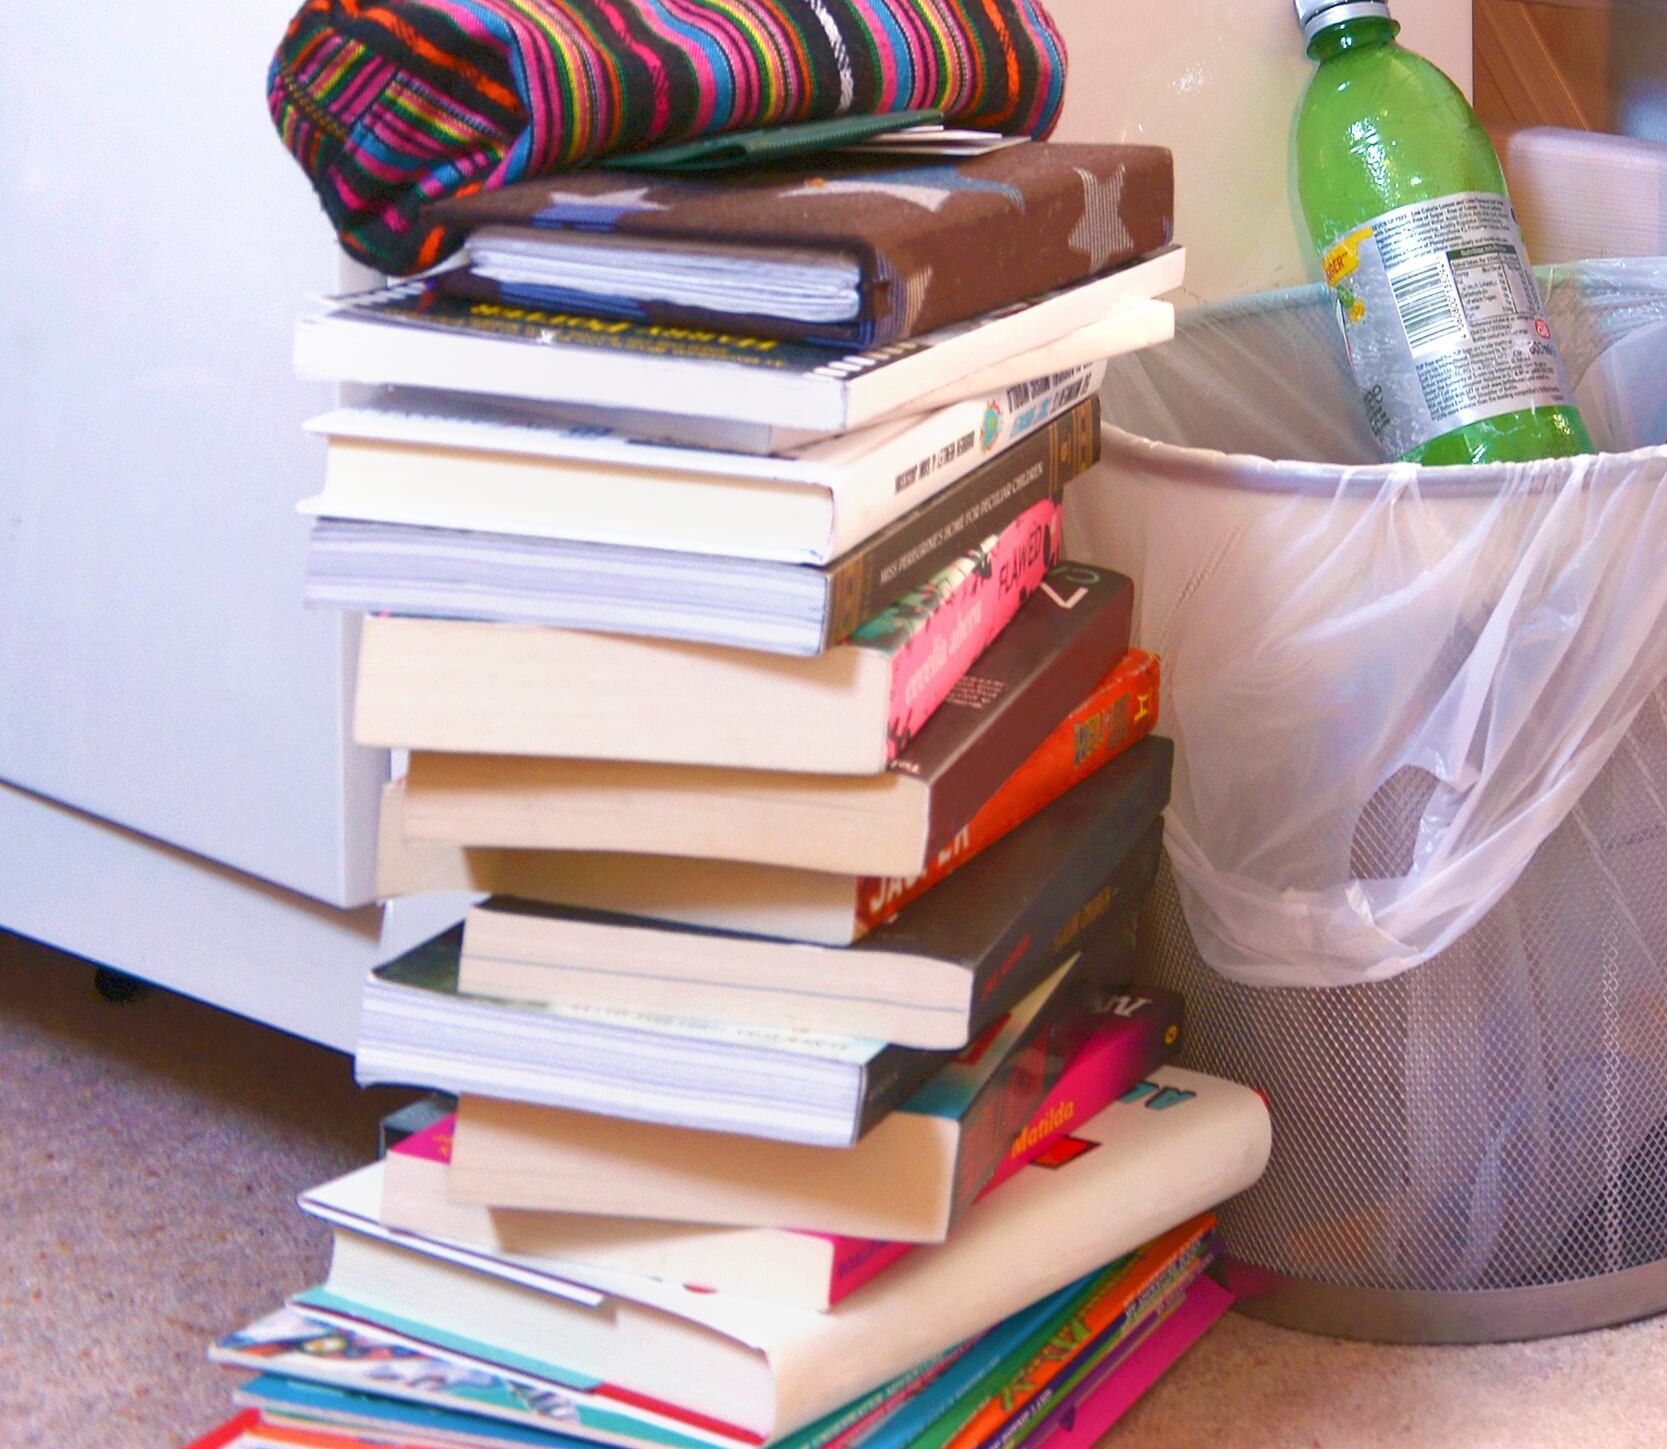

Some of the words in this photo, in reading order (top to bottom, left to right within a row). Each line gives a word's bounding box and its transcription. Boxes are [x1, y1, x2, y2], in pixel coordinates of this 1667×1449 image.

[880, 563, 898, 584] MISS
[943, 516, 965, 546] HOME
[965, 505, 980, 529] FOR
[980, 483, 1012, 516] PECULIAR
[1012, 460, 1045, 496] CHILDREN
[999, 525, 1043, 595] FLAWED
[1010, 1099, 1075, 1158] Matilda
